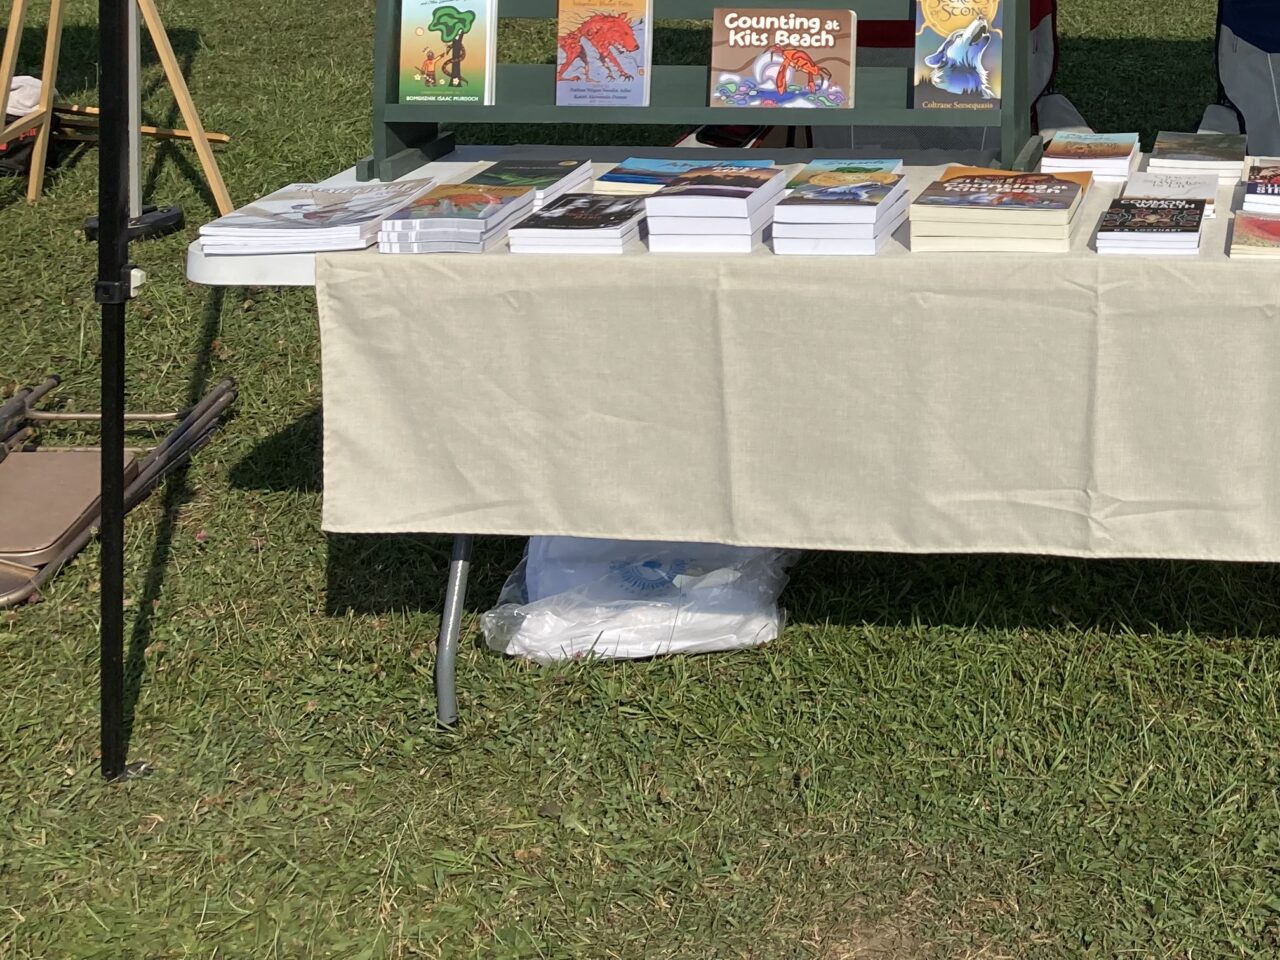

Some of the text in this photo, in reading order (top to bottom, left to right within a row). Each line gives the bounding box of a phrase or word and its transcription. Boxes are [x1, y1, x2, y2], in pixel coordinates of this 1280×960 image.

[940, 4, 987, 22] STONE
[724, 12, 840, 34] Counting at
[729, 29, 835, 47] Kits Beach
[922, 101, 953, 109] Coltrane
